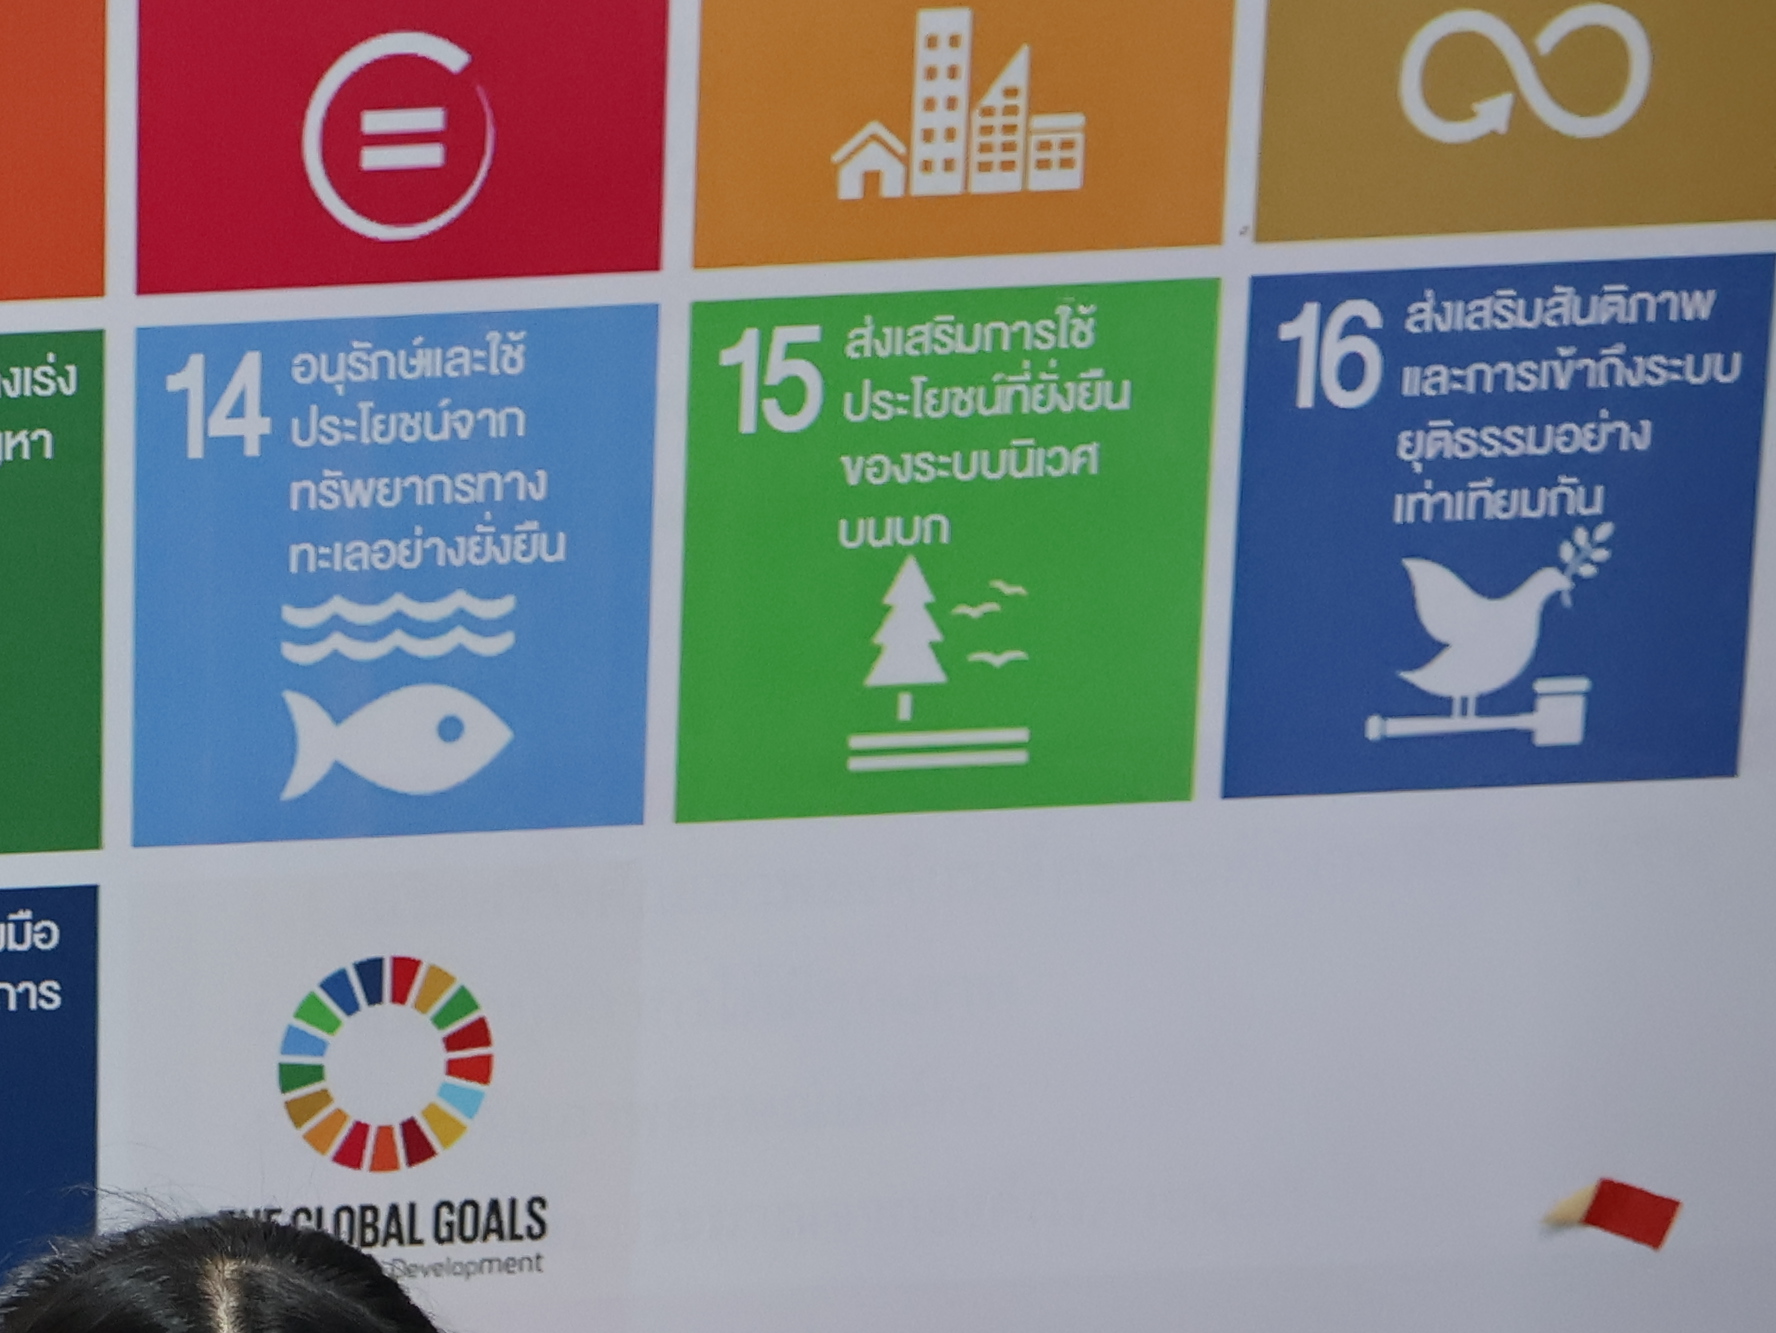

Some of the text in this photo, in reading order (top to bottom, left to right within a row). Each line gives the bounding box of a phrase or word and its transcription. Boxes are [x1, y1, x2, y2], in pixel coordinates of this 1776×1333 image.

[844, 304, 1097, 359] ส่งเสริมการใช้
[1403, 284, 1716, 334] ส่งเสริมสันติภาพ
[291, 330, 527, 396] อนุรักษ์และใช้
[718, 324, 824, 434] 15
[1277, 299, 1384, 409] 16
[1401, 343, 1743, 397] และการเข้าถึงระบบ
[165, 350, 272, 459] 14
[843, 359, 1132, 422] ประโยชน์ที่ยั่งยืน
[291, 398, 527, 448] ประโยชน์จาก
[1396, 408, 1651, 474] ยุติธรรมอย่าง
[839, 438, 1100, 486] ของระบบนิเวศ
[290, 469, 549, 511] ทรัพยากรทาง
[1392, 474, 1605, 524] เท่าเทียมกัน
[289, 511, 567, 574] ทะเลอย่างยั่งยืน
[837, 512, 951, 549] บนบก
[432, 1196, 547, 1245] GOALS
